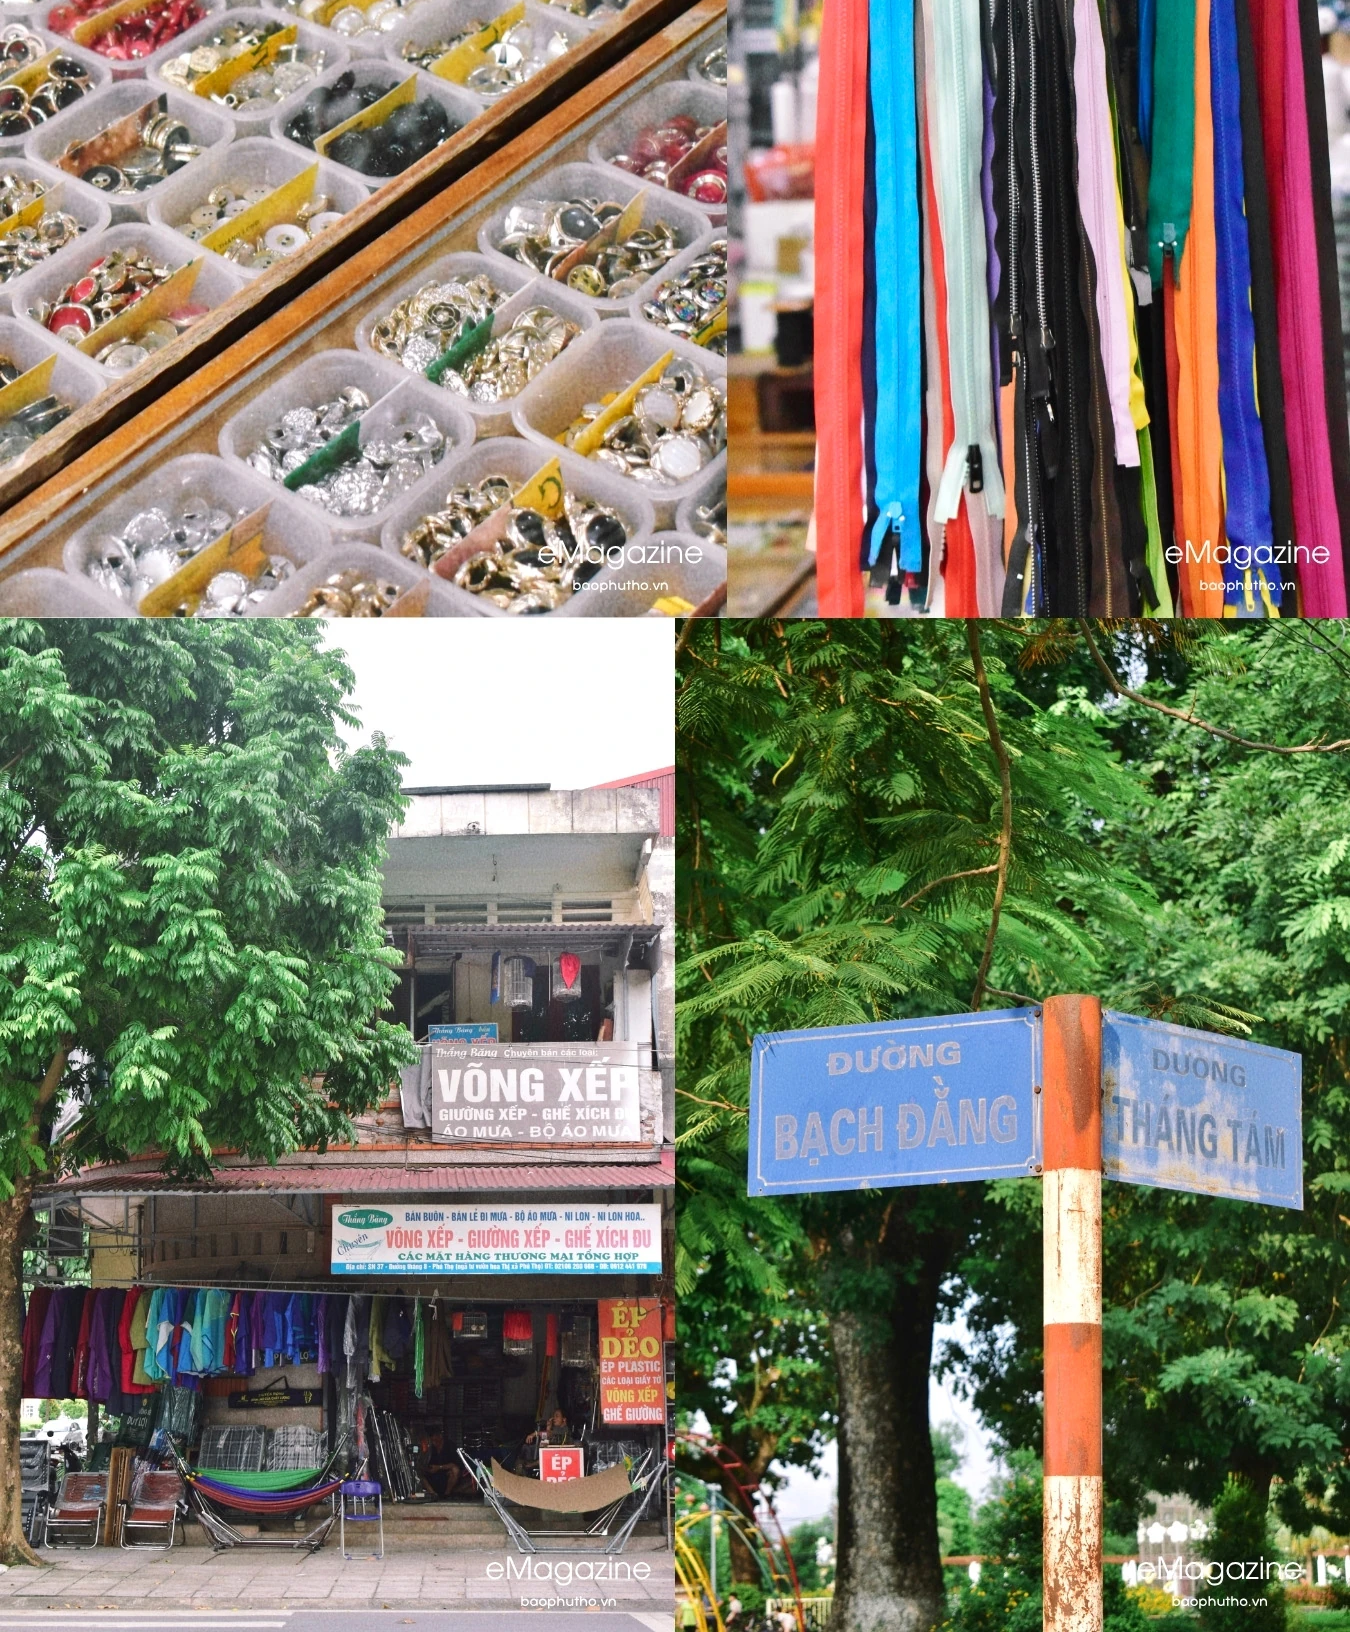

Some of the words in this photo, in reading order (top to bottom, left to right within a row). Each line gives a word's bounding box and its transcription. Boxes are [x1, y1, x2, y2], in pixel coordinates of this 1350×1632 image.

[504, 1049, 539, 1057] Chuyên
[541, 1048, 558, 1057] bán
[826, 1039, 961, 1076] ĐƯỜNG
[438, 1062, 545, 1103] VÕNG
[558, 1056, 638, 1102] XẾP
[439, 1106, 494, 1121] GIƯỜNG
[498, 1104, 527, 1121] XẾP
[542, 1104, 571, 1121] GHẾ
[576, 1105, 612, 1120] XÍCH
[775, 1105, 884, 1166] BẠCH
[896, 1075, 1017, 1150] ĐẰNG
[441, 1124, 468, 1138] ÁO
[473, 1124, 512, 1138] MƯA
[530, 1123, 556, 1140] BỘ
[561, 1123, 587, 1138] ÁO
[592, 1123, 633, 1138] MƯA
[1112, 1094, 1218, 1159] THÁNG
[1227, 1110, 1286, 1170] TÁM
[342, 1213, 366, 1225] Thắng
[405, 1210, 421, 1222] BÁN
[423, 1211, 444, 1222] BUÔN
[451, 1210, 468, 1222] BÁN
[480, 1212, 488, 1222] ĐI
[490, 1211, 508, 1222] MƯA
[515, 1210, 525, 1223] BỘ
[527, 1210, 537, 1222] ÁO
[540, 1211, 557, 1222] MƯA
[564, 1211, 573, 1221] NI
[575, 1211, 590, 1221] LON
[598, 1211, 606, 1221] NI
[608, 1211, 622, 1221] LON
[337, 1233, 369, 1256] Chuyên
[386, 1226, 422, 1249] VÕNG
[427, 1223, 454, 1249] XẾP
[467, 1225, 519, 1249] GIƯỜNG
[523, 1223, 551, 1249] XẾP
[564, 1223, 592, 1249] GHẾ
[596, 1225, 628, 1249] XÍCH
[633, 1229, 651, 1249] ĐU
[398, 1251, 423, 1261] CÁC
[425, 1251, 452, 1262] MẶT
[455, 1251, 491, 1261] HÀNG
[494, 1252, 547, 1261] THƯƠNG
[550, 1252, 574, 1262] MẠI
[576, 1249, 610, 1261] TỔNG
[614, 1252, 639, 1262] HỢP
[611, 1300, 647, 1328] ÉP
[601, 1328, 660, 1358] DẺO
[601, 1359, 615, 1373] ÉP
[618, 1361, 660, 1373] PLASTIC
[601, 1375, 615, 1385] CÁC
[618, 1376, 633, 1386] LOẠI
[634, 1374, 651, 1385] GIẤY
[606, 1387, 635, 1403] VÕNG
[638, 1385, 658, 1403] XẾP
[603, 1404, 622, 1421] GHẾ
[625, 1404, 663, 1421] GIƯỜNG
[551, 1454, 572, 1471] ÉP
